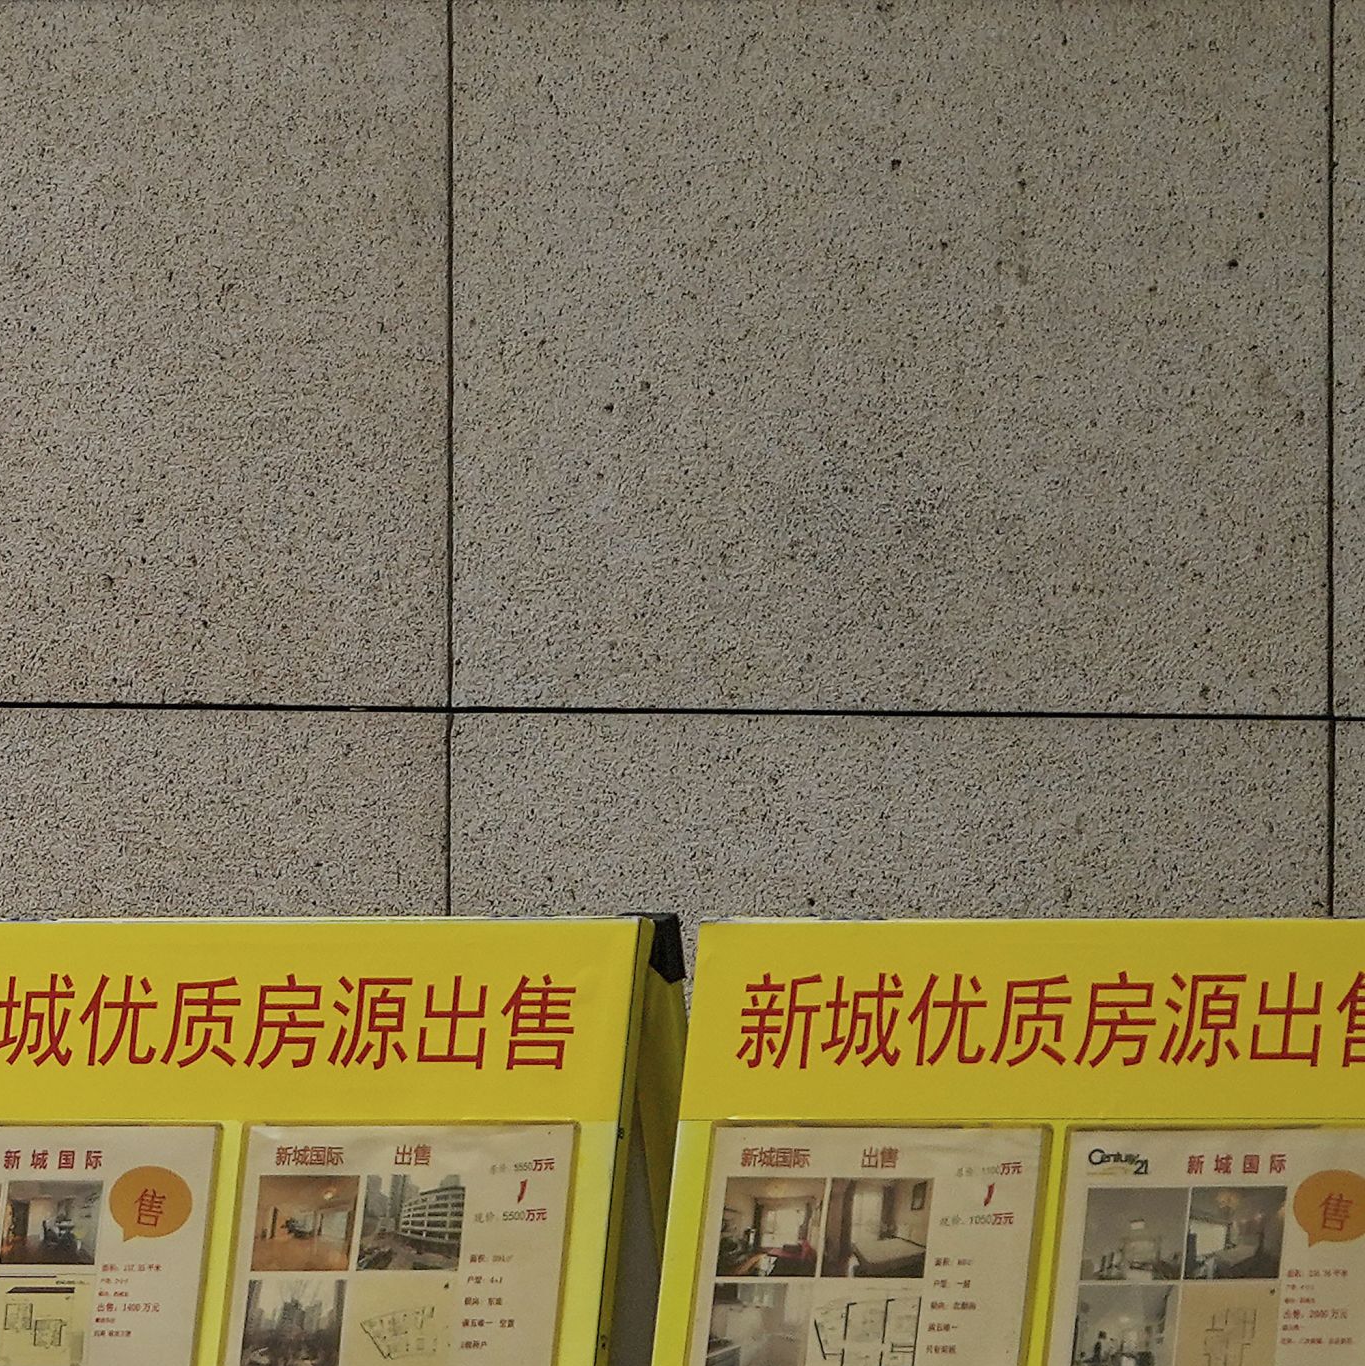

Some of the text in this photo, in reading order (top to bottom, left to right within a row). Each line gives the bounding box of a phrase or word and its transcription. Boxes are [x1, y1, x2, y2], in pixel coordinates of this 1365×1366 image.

[4, 1150, 103, 1170] 新城国际
[276, 1144, 431, 1166] 新城国际 出售
[741, 1148, 899, 1169] 新城国际 出售
[1188, 1154, 1287, 1175] 新城国际
[134, 1188, 166, 1227] 售
